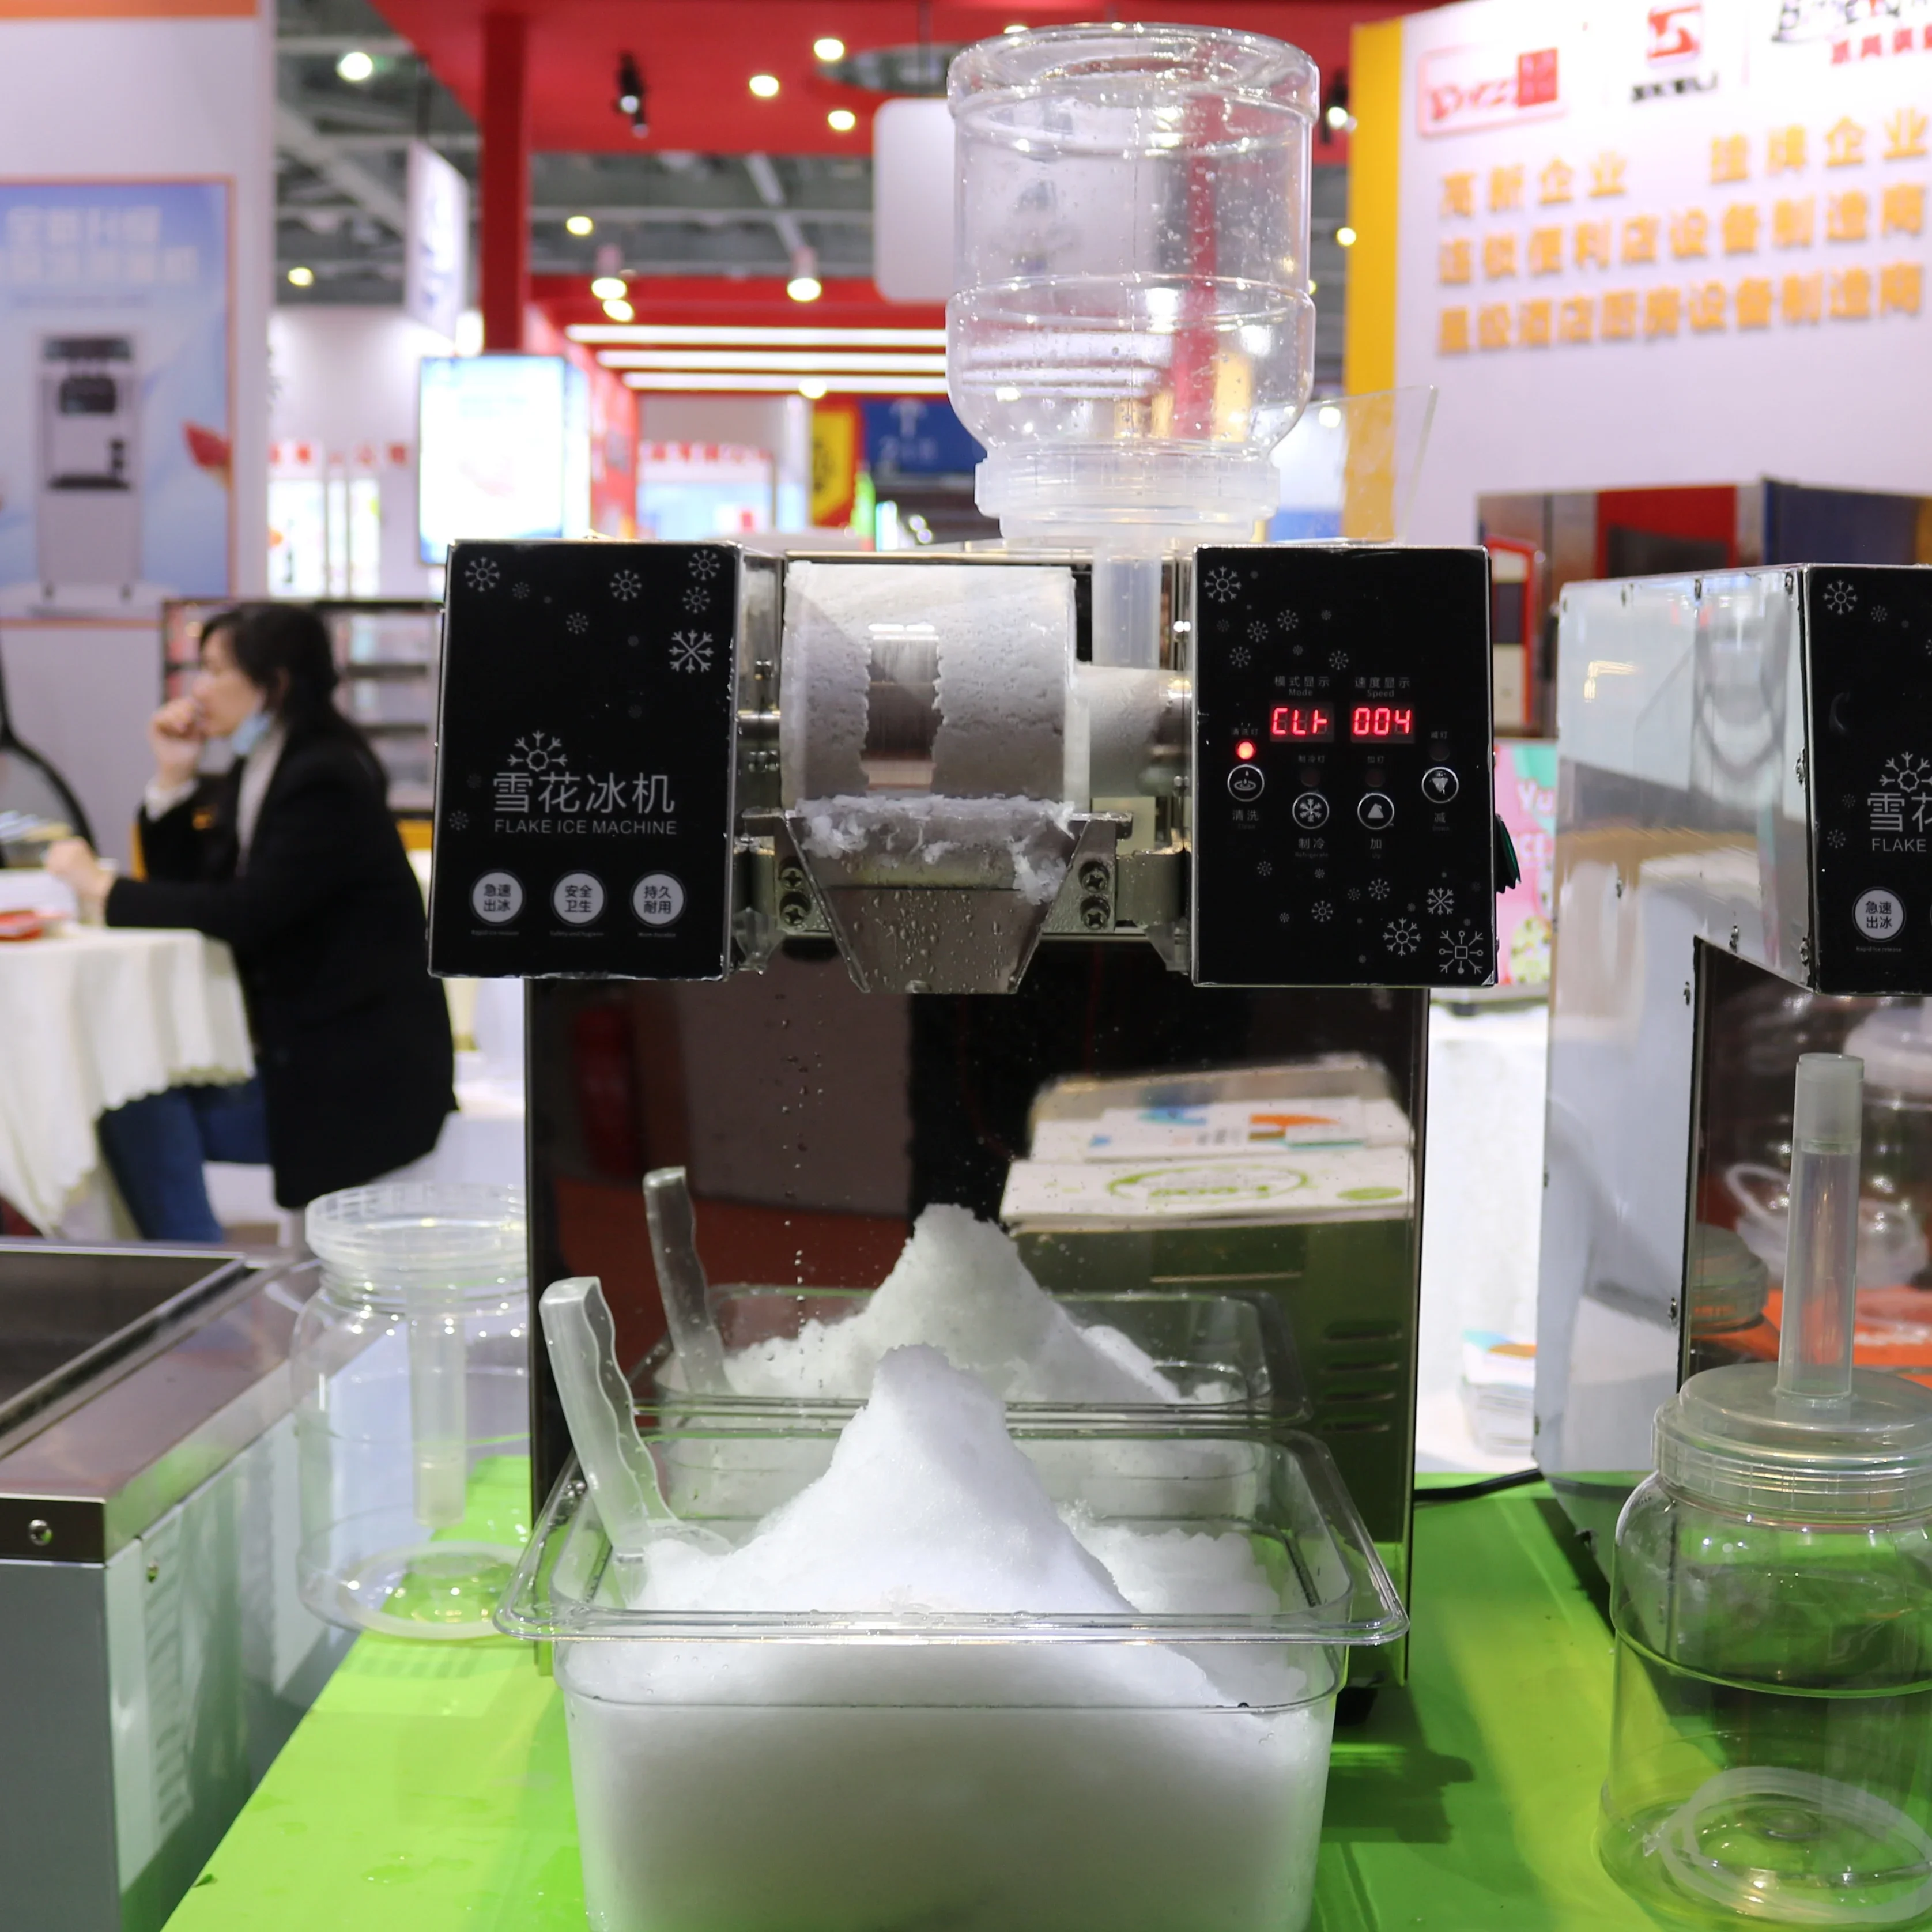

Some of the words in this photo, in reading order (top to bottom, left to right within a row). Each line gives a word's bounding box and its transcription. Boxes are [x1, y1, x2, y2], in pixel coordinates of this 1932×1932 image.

[1274, 676, 1330, 688] 模式显示
[1355, 677, 1410, 689] 速度显示
[1289, 688, 1313, 696] Mode
[1367, 690, 1394, 699] Speed
[1353, 707, 1411, 735] 004
[493, 772, 675, 814] 雪花冰机
[495, 819, 552, 833] FLAKE
[557, 820, 587, 833] ICE
[593, 821, 677, 835] MACHINE
[1298, 837, 1325, 850] 制冷
[1370, 837, 1382, 850] 加
[1872, 838, 1927, 852] FLAKE
[483, 884, 511, 897] 急速
[565, 885, 593, 898] 安全
[643, 886, 671, 899] 持久
[483, 899, 511, 912] 出冰
[564, 900, 593, 913] 卫生
[643, 901, 672, 914] 耐用
[1865, 901, 1892, 914] 急速
[1866, 916, 1892, 929] 出冰
